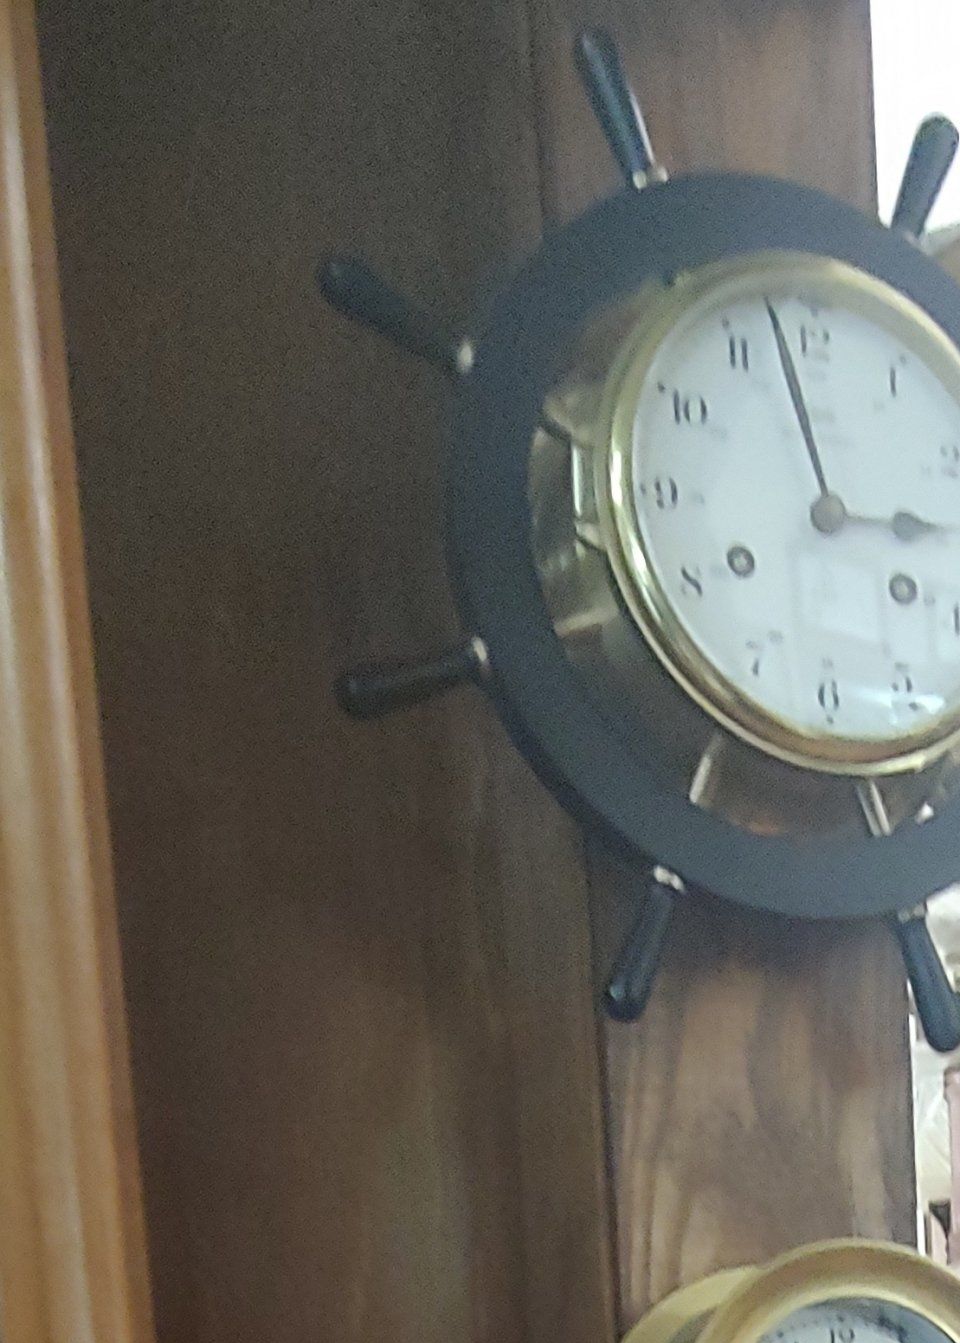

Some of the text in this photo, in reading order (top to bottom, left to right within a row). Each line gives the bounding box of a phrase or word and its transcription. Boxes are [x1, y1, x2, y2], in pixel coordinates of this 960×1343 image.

[727, 335, 750, 372] 11
[888, 366, 898, 398] 1
[672, 390, 709, 425] 10
